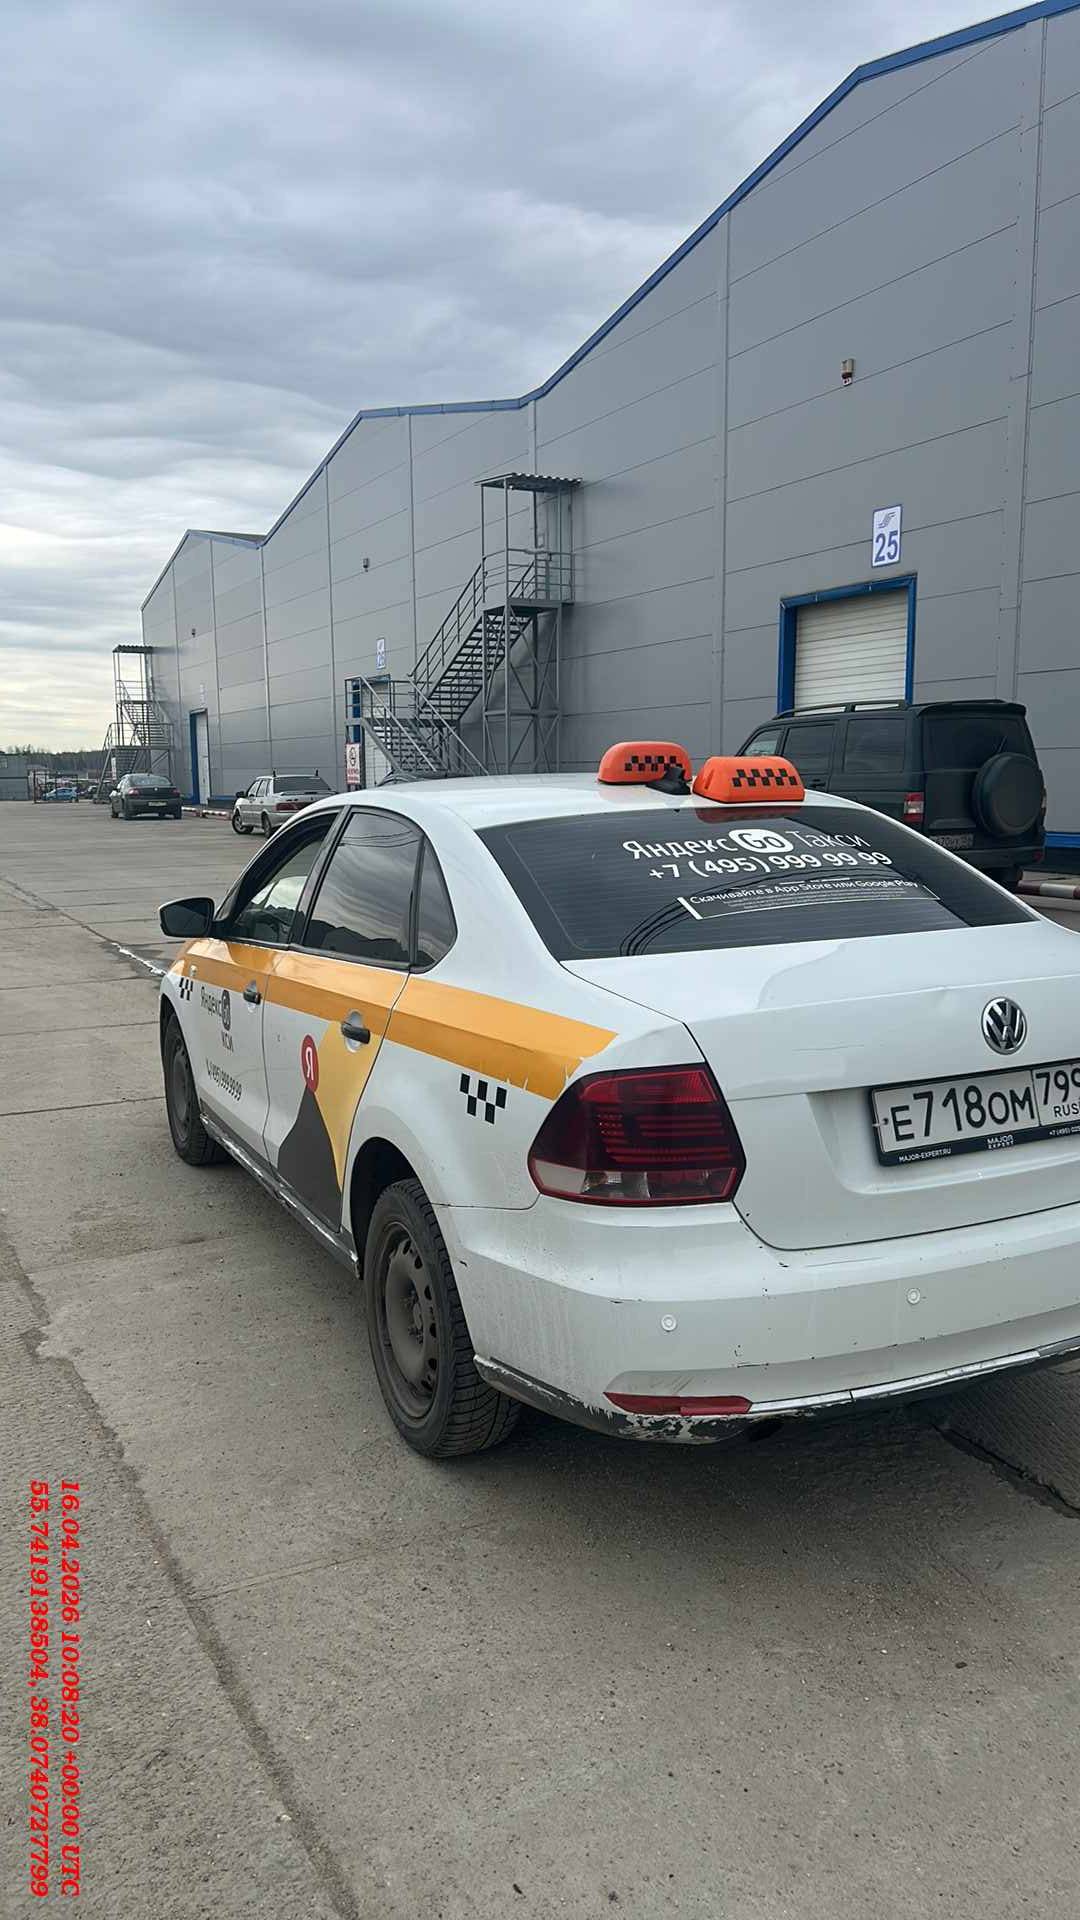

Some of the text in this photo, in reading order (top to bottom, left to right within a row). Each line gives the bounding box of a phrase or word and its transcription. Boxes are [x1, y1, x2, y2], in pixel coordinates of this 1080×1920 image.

[874, 530, 898, 563] 25
[622, 830, 871, 859] Яндекс Go Такси
[649, 851, 893, 878] +7 (495) 999 99 99
[689, 888, 764, 904] Скачивайте
[774, 885, 799, 893] App
[799, 882, 833, 891] Store
[855, 880, 895, 888] Google
[305, 1046, 314, 1081] Я
[1054, 1102, 1079, 1118] RUS
[987, 1134, 1014, 1145] MAJOR
